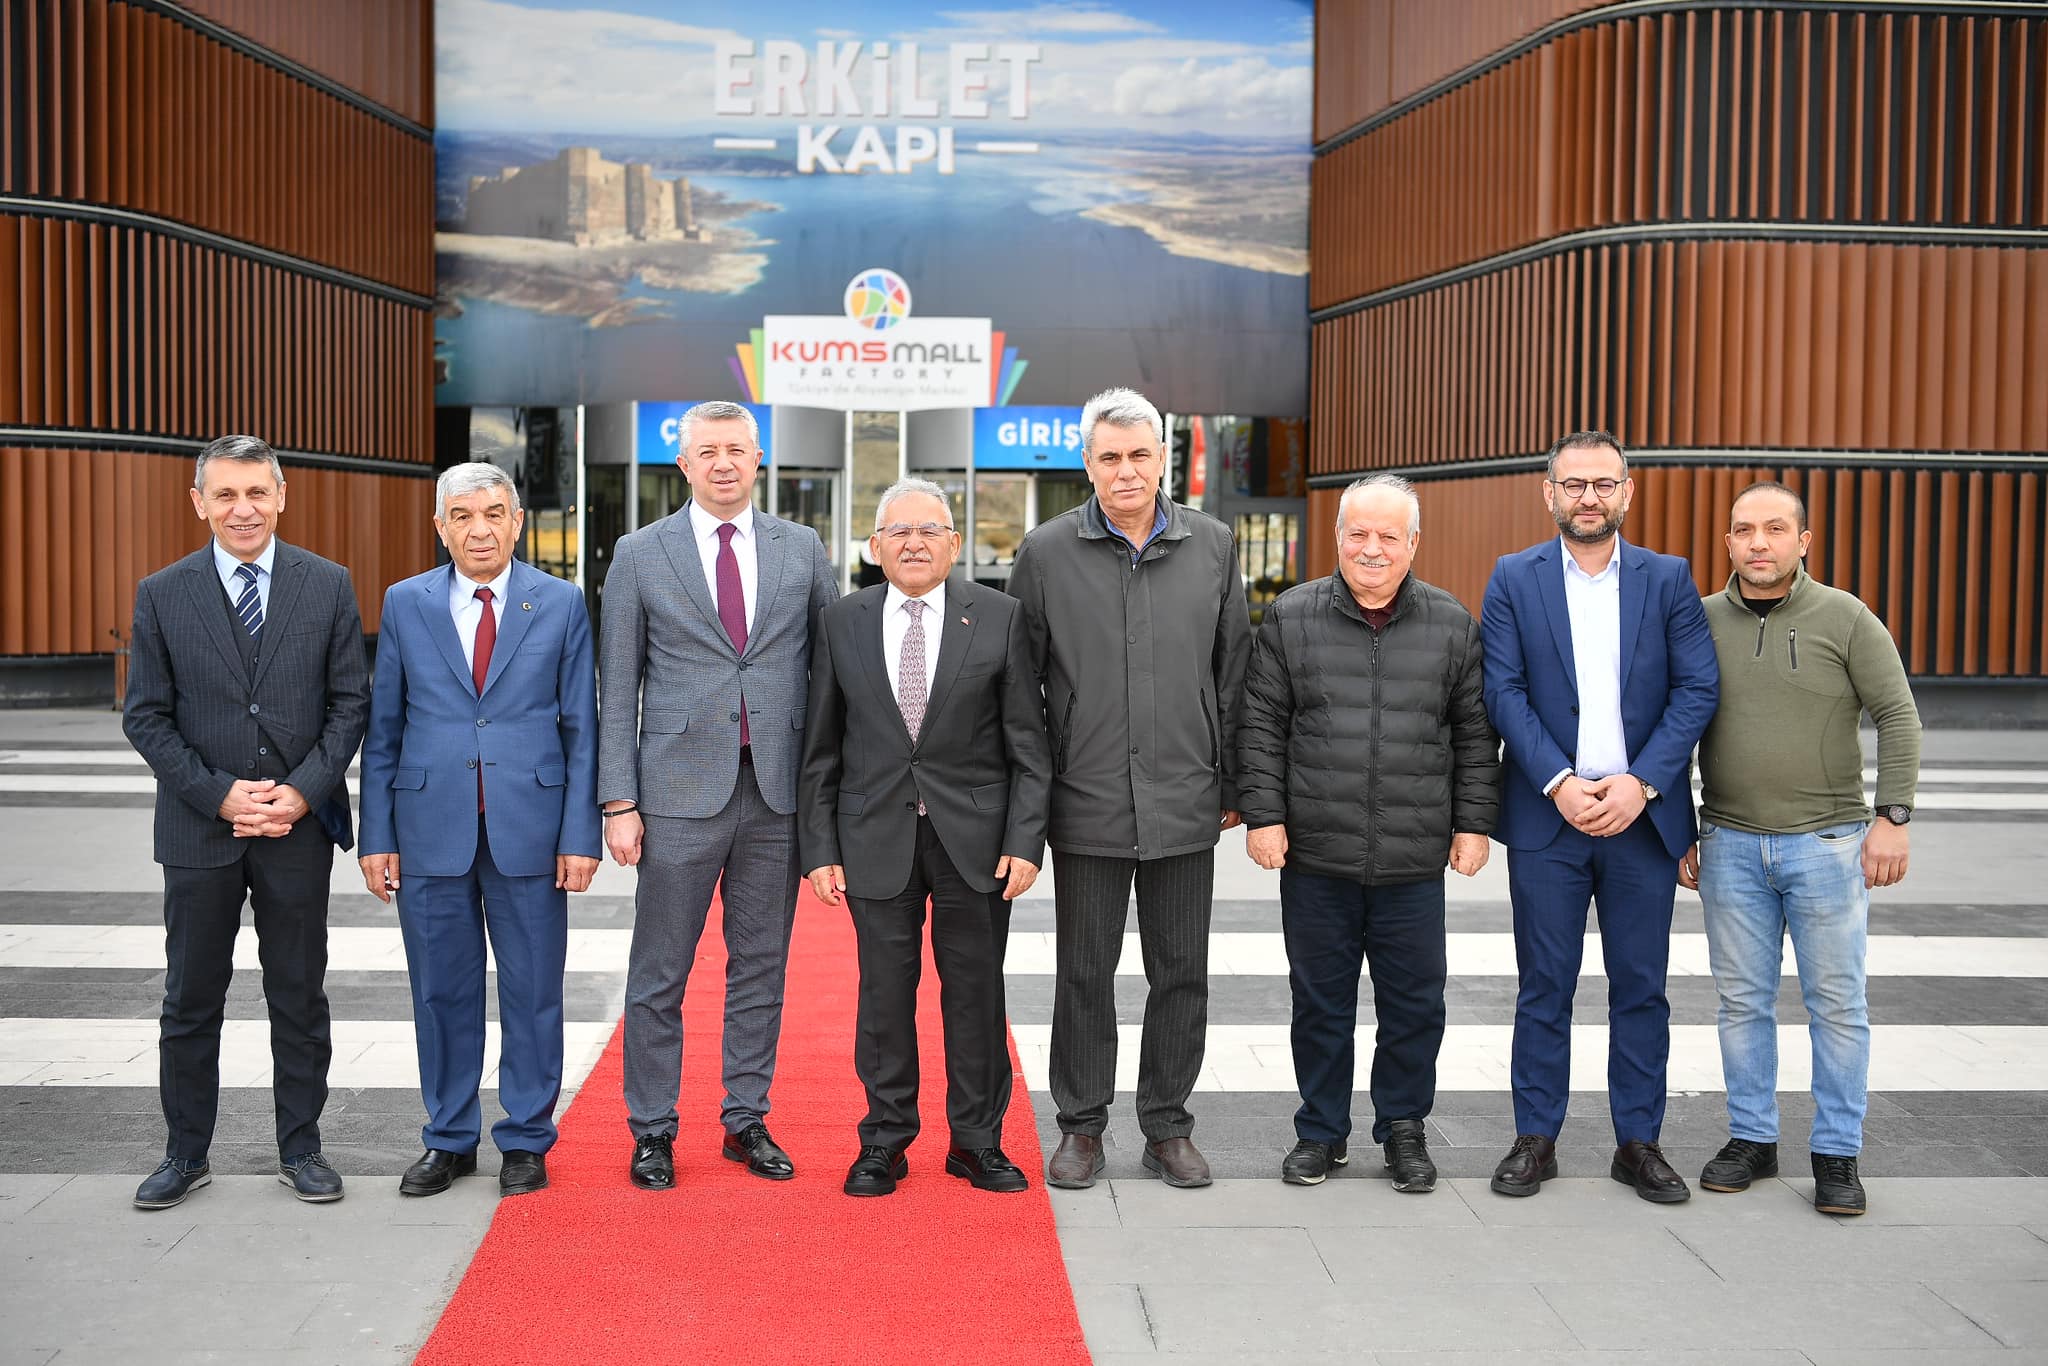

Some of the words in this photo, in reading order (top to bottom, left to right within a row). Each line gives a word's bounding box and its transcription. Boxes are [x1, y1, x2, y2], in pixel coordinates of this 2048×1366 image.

[797, 126, 955, 173] KAPI
[799, 368, 954, 379] FACTORY
[998, 418, 1081, 451] GİRİŞ
